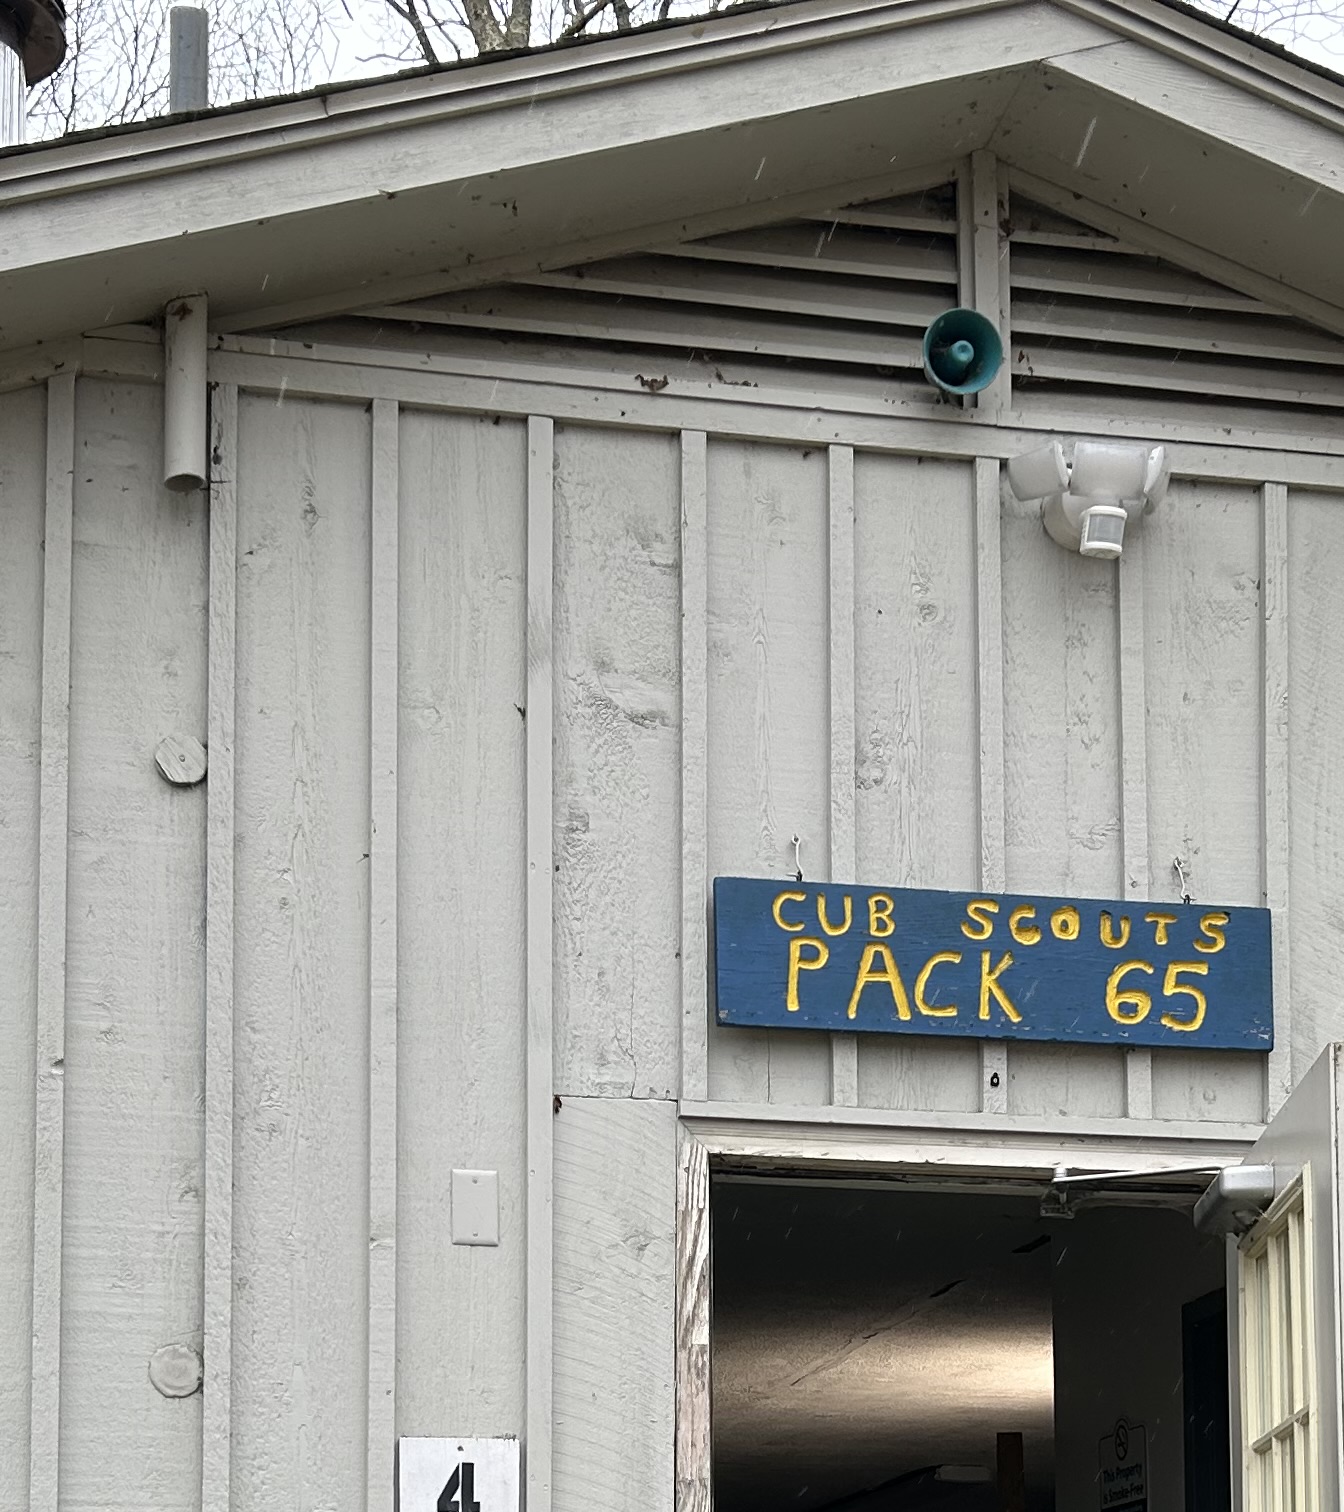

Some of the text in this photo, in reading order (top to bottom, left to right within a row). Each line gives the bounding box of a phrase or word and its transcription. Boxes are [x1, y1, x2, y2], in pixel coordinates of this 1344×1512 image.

[772, 890, 1231, 954] CUB SCOUTS
[786, 936, 1210, 1032] PACK 65
